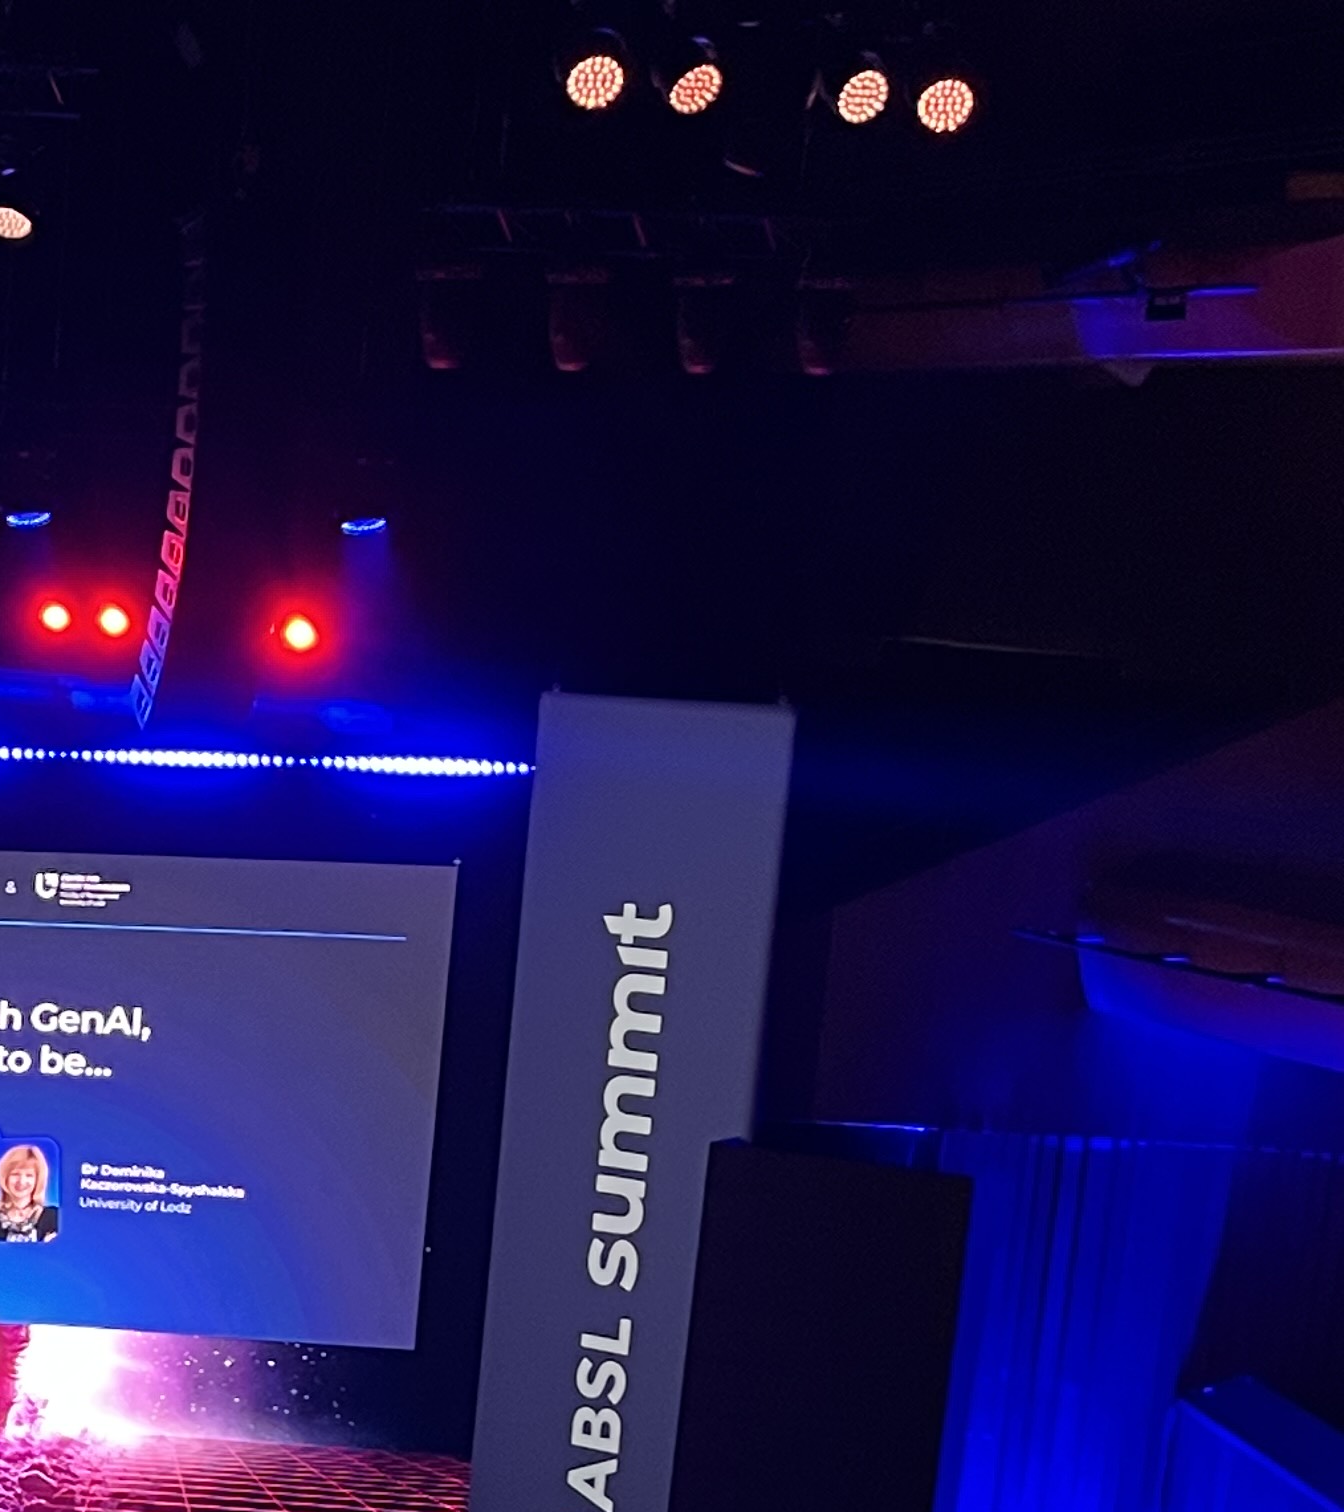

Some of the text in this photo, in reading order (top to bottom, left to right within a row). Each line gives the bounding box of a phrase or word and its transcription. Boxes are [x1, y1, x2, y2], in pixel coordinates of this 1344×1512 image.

[31, 1002, 151, 1041] GenAI,
[40, 1044, 112, 1077] be...
[586, 901, 674, 1292] summit
[82, 1163, 165, 1179] Dr Dominika
[80, 1196, 192, 1214] University of Lodz
